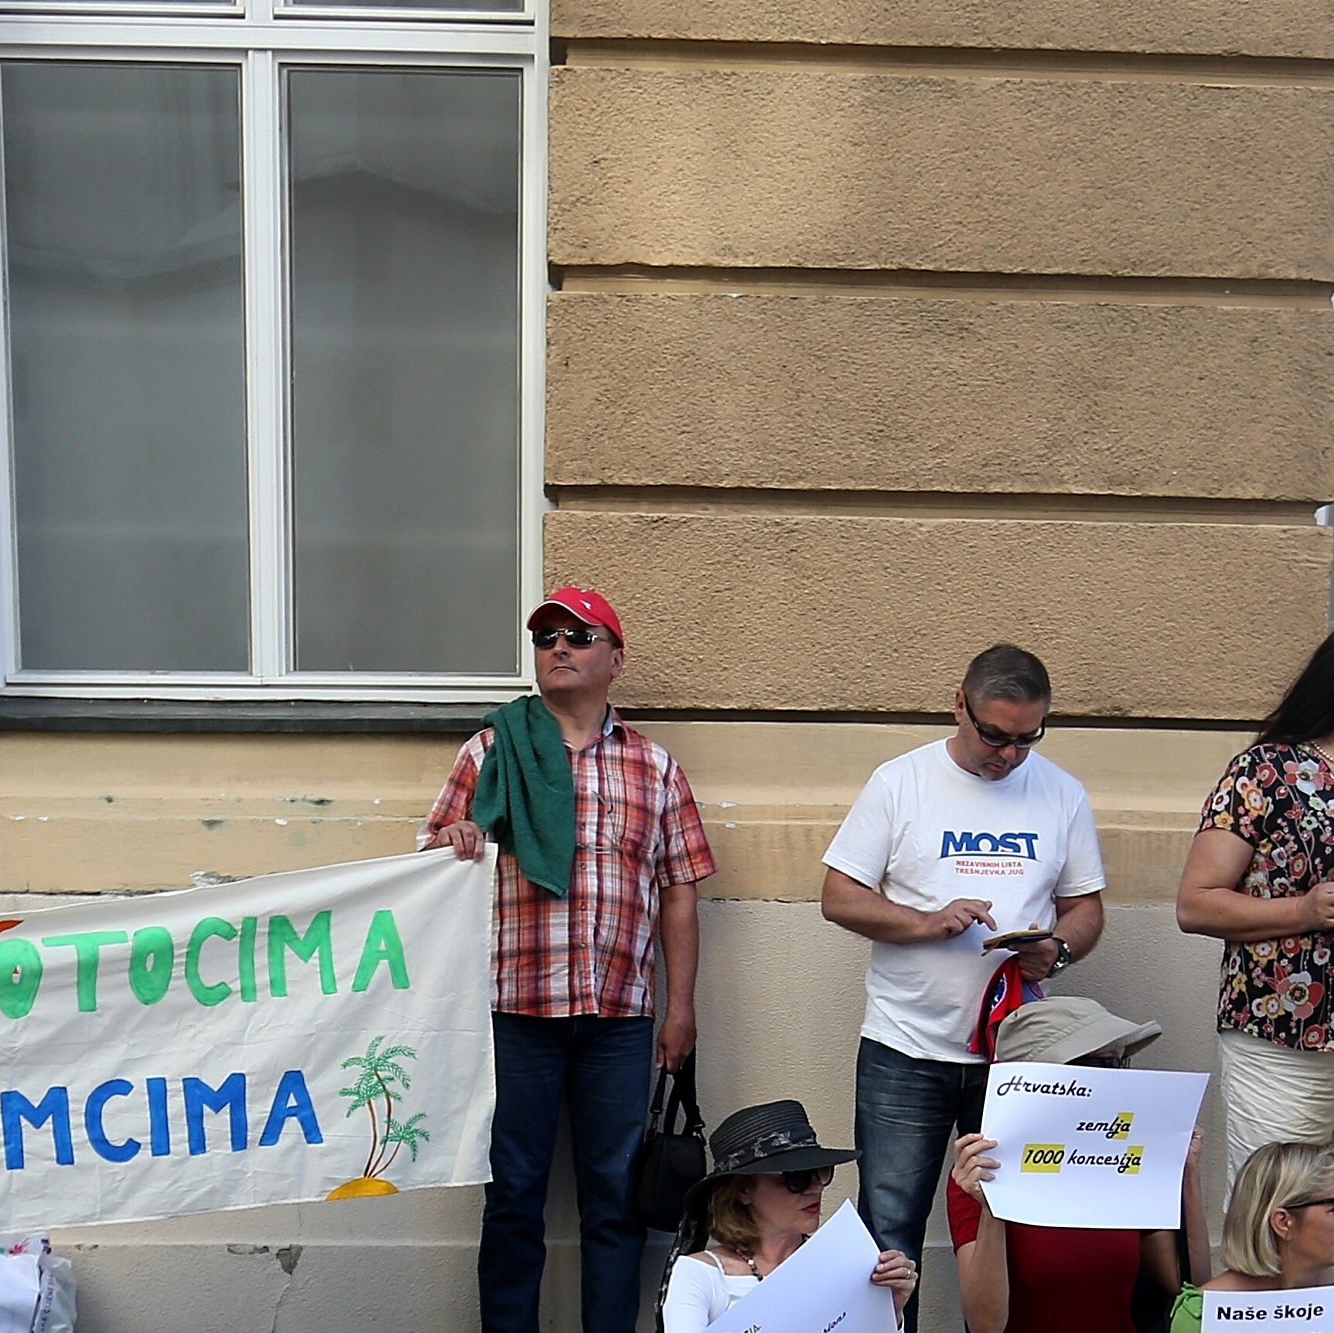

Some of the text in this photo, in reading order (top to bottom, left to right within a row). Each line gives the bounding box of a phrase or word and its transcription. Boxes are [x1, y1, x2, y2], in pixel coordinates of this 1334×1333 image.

[939, 831, 1039, 860] MOST
[996, 1075, 1093, 1097] Hrvatska:
[1076, 1116, 1131, 1140] zemlja
[1024, 1149, 1142, 1174] 1000 koncesija
[1216, 1303, 1325, 1321] Naše škoje
